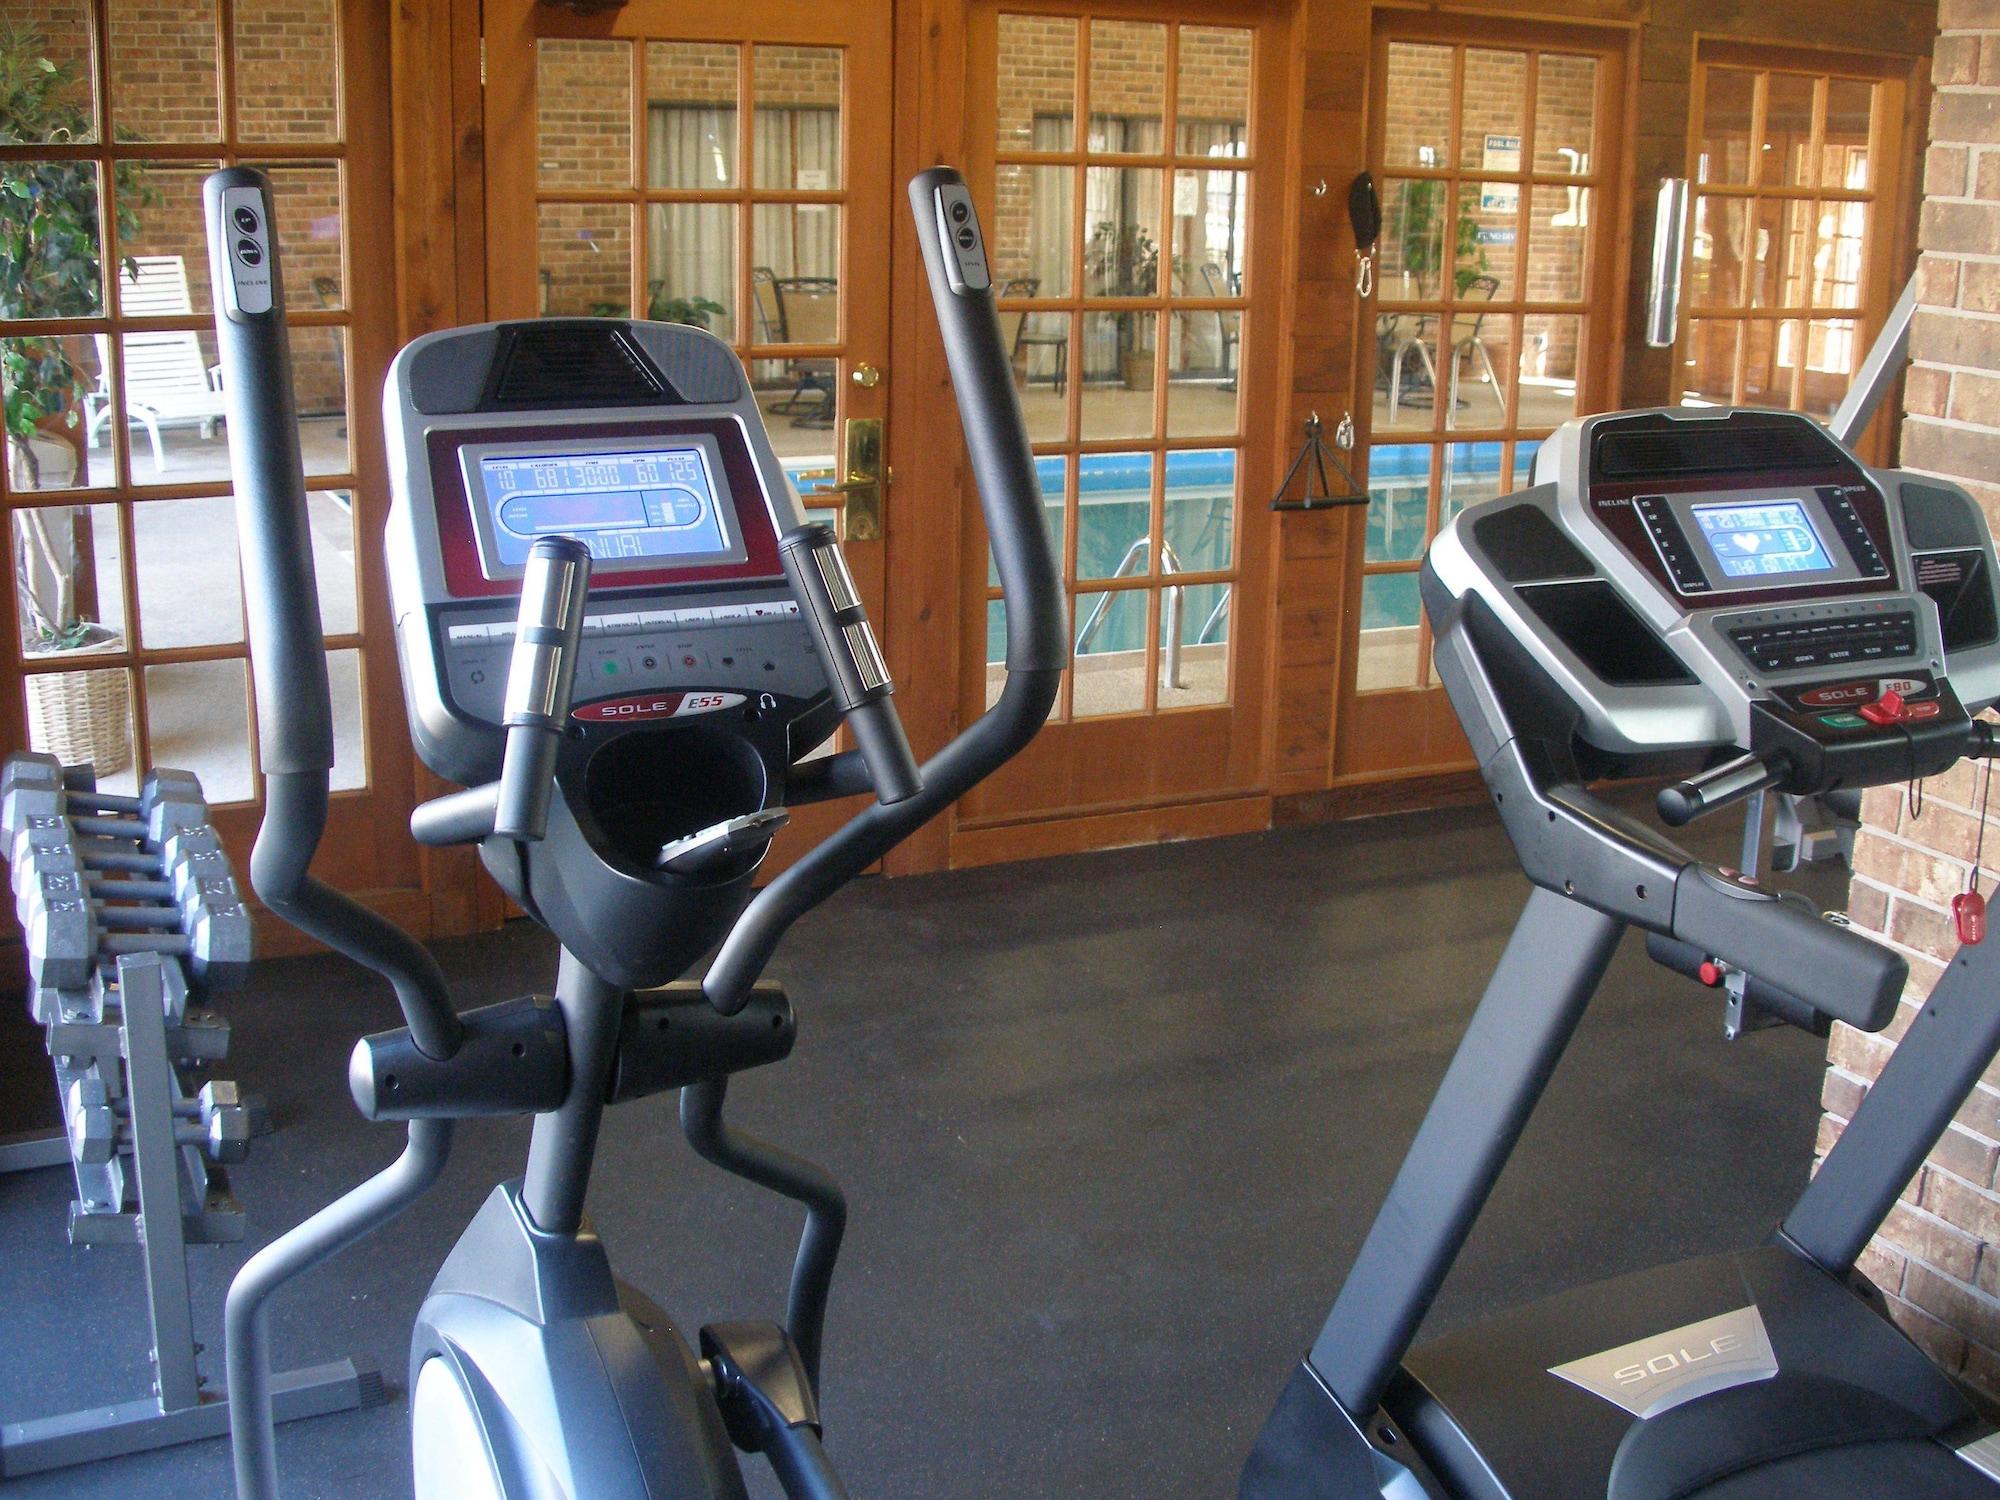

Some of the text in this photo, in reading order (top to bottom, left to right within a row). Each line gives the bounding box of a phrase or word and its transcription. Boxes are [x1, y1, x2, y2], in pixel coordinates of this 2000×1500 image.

[498, 470, 516, 489] 10
[636, 463, 660, 483] 60
[668, 460, 697, 481] 125
[1598, 498, 1630, 507] INCLINE
[1829, 650, 1850, 659] ENTER
[1818, 687, 1869, 701] SOLE
[602, 695, 724, 716] SOLE E55
[1613, 1333, 1742, 1386] SOLE
